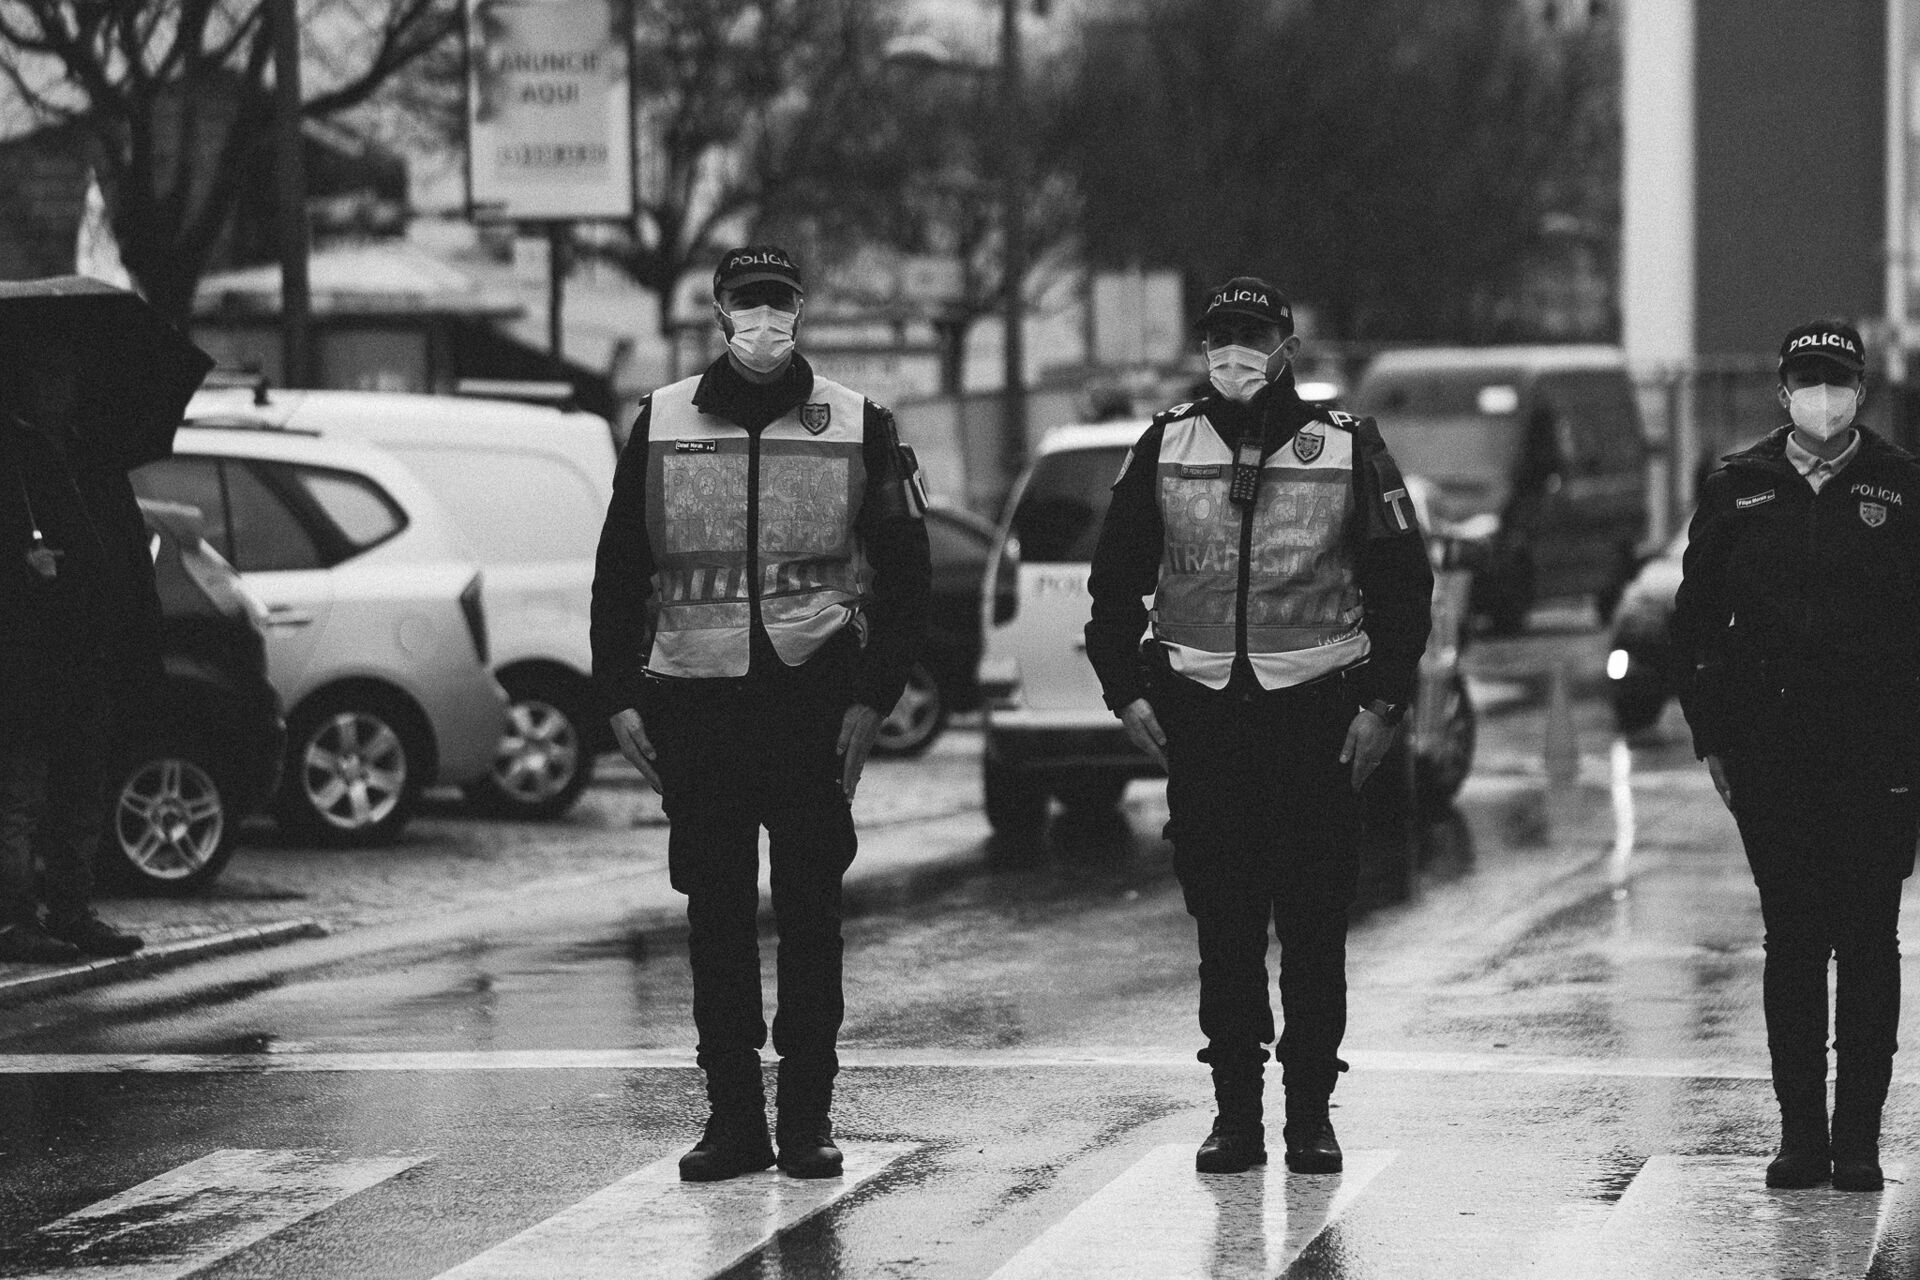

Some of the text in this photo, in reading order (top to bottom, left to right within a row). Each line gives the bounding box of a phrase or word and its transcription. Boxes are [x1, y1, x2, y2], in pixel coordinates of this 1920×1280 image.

[521, 82, 579, 104] AQUI
[1789, 332, 1857, 353] POLÍCIA
[1164, 491, 1334, 530] POLCIA
